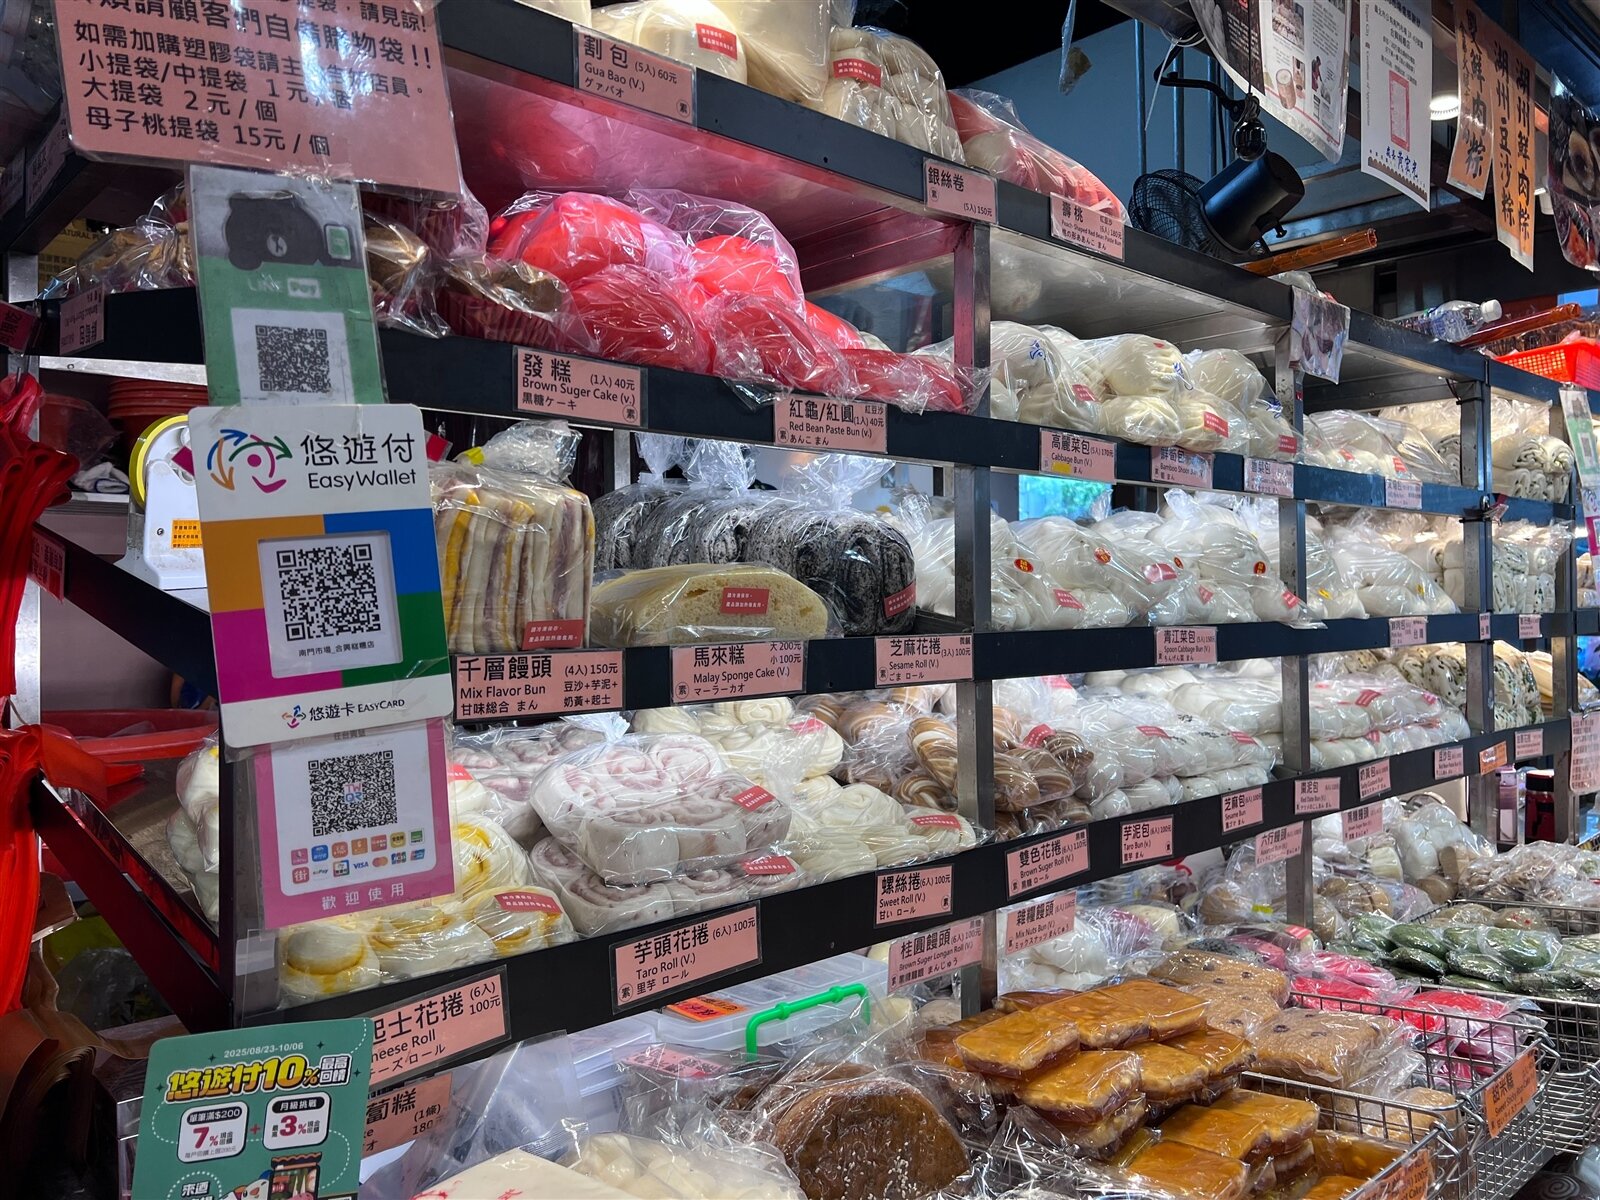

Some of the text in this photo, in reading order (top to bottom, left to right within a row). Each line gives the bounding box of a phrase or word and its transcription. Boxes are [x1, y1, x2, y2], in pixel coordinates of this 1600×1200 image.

[584, 34, 629, 69] 割包
[657, 69, 678, 84] 60元
[79, 49, 248, 93] 小提袋/中提袋
[584, 62, 626, 85] Gua Bao
[82, 77, 164, 107] 大提袋
[86, 106, 219, 143] 母子桃提袋
[928, 166, 964, 192] 銀絲卷
[523, 353, 571, 383] 發糕
[522, 377, 617, 402] Brown Suger Cake
[615, 377, 635, 391] 40元
[789, 421, 860, 436] Red Bean Paste Bun
[869, 418, 885, 428] 40元
[300, 432, 416, 467] 悠遊付
[1051, 452, 1083, 464] Cabbage Bun
[307, 468, 417, 492] EasyWallet
[693, 644, 745, 668] 馬來糕
[770, 641, 802, 651] 大 200元
[890, 637, 941, 657] 芝麻花捲
[955, 647, 971, 656] 100元
[1178, 646, 1195, 654] Cabbage
[458, 654, 553, 682] 千層饅頭
[590, 662, 619, 675] 150元
[779, 655, 802, 664] 100元
[889, 659, 928, 670] Sesame Roll
[693, 668, 775, 684] Malay Sponge Cake
[905, 672, 924, 680] ロール
[460, 684, 546, 699] Mix Flavor Bun
[309, 702, 356, 721] 悠遊卡
[517, 699, 539, 712] まん
[1123, 823, 1150, 841] 芋泥包
[1019, 840, 1061, 868] 雙色花捲
[1135, 841, 1143, 849] Bun
[1020, 857, 1064, 879] Brown Suger Roll
[881, 872, 920, 895] 螺絲捲
[934, 873, 951, 885] 100元
[321, 882, 404, 910] 歡迎使用
[879, 893, 914, 908] Sweet Roll
[896, 906, 916, 916] ロール
[633, 922, 709, 964] 芋頭花捲
[733, 917, 756, 933] 100元
[900, 928, 951, 960] 桂圓饅頭
[965, 928, 982, 938] 100元
[636, 957, 678, 980] Taro Roll
[899, 944, 963, 972] Brown Suger Longan Roll
[636, 969, 689, 995] 里芋 ロール
[469, 994, 501, 1015] 100元
[223, 1042, 304, 1059] 2025/08/23-10/06
[371, 1029, 436, 1063] heese Roll
[366, 1088, 417, 1125] 蔔糕
[279, 1114, 307, 1137] 3%
[192, 1126, 218, 1149] 7%
